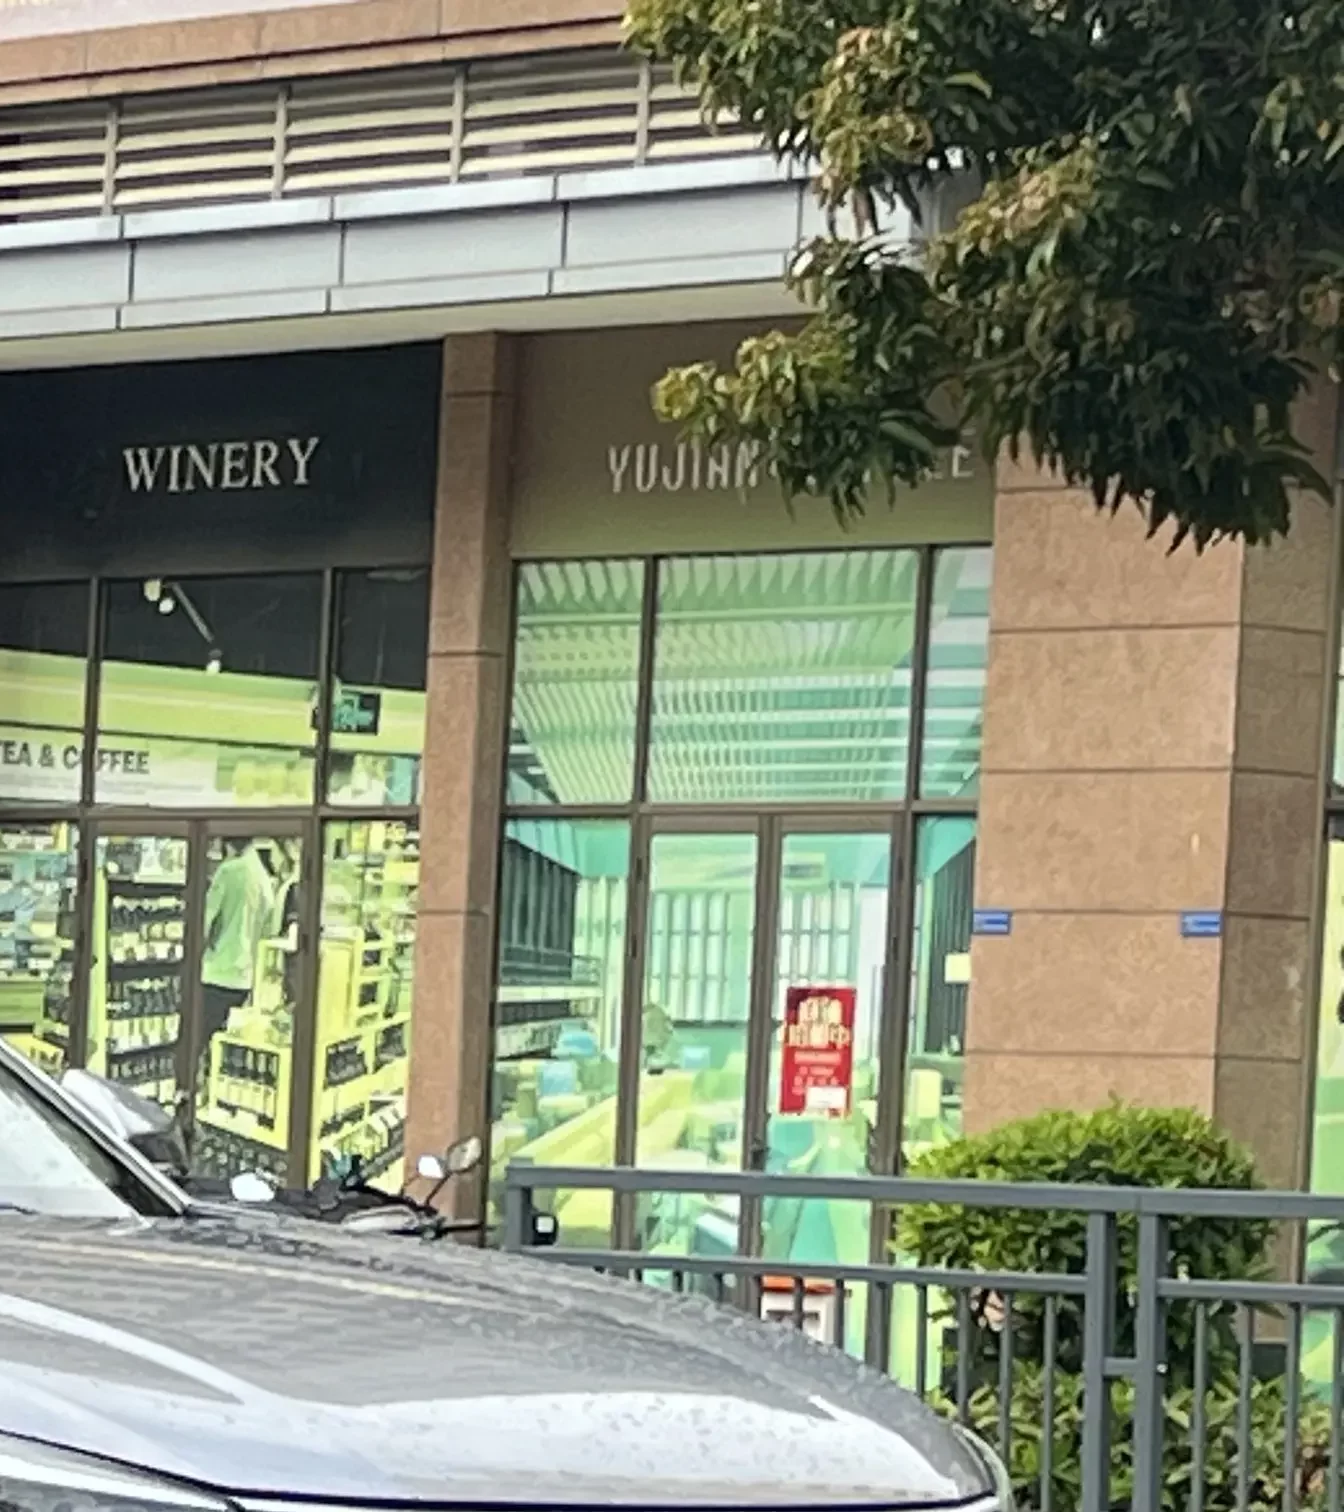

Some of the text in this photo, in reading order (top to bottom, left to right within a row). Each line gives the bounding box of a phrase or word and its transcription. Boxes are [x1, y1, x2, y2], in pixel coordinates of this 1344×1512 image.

[122, 437, 319, 492] WINERY
[38, 744, 55, 767] &
[63, 745, 150, 774] CFFEE
